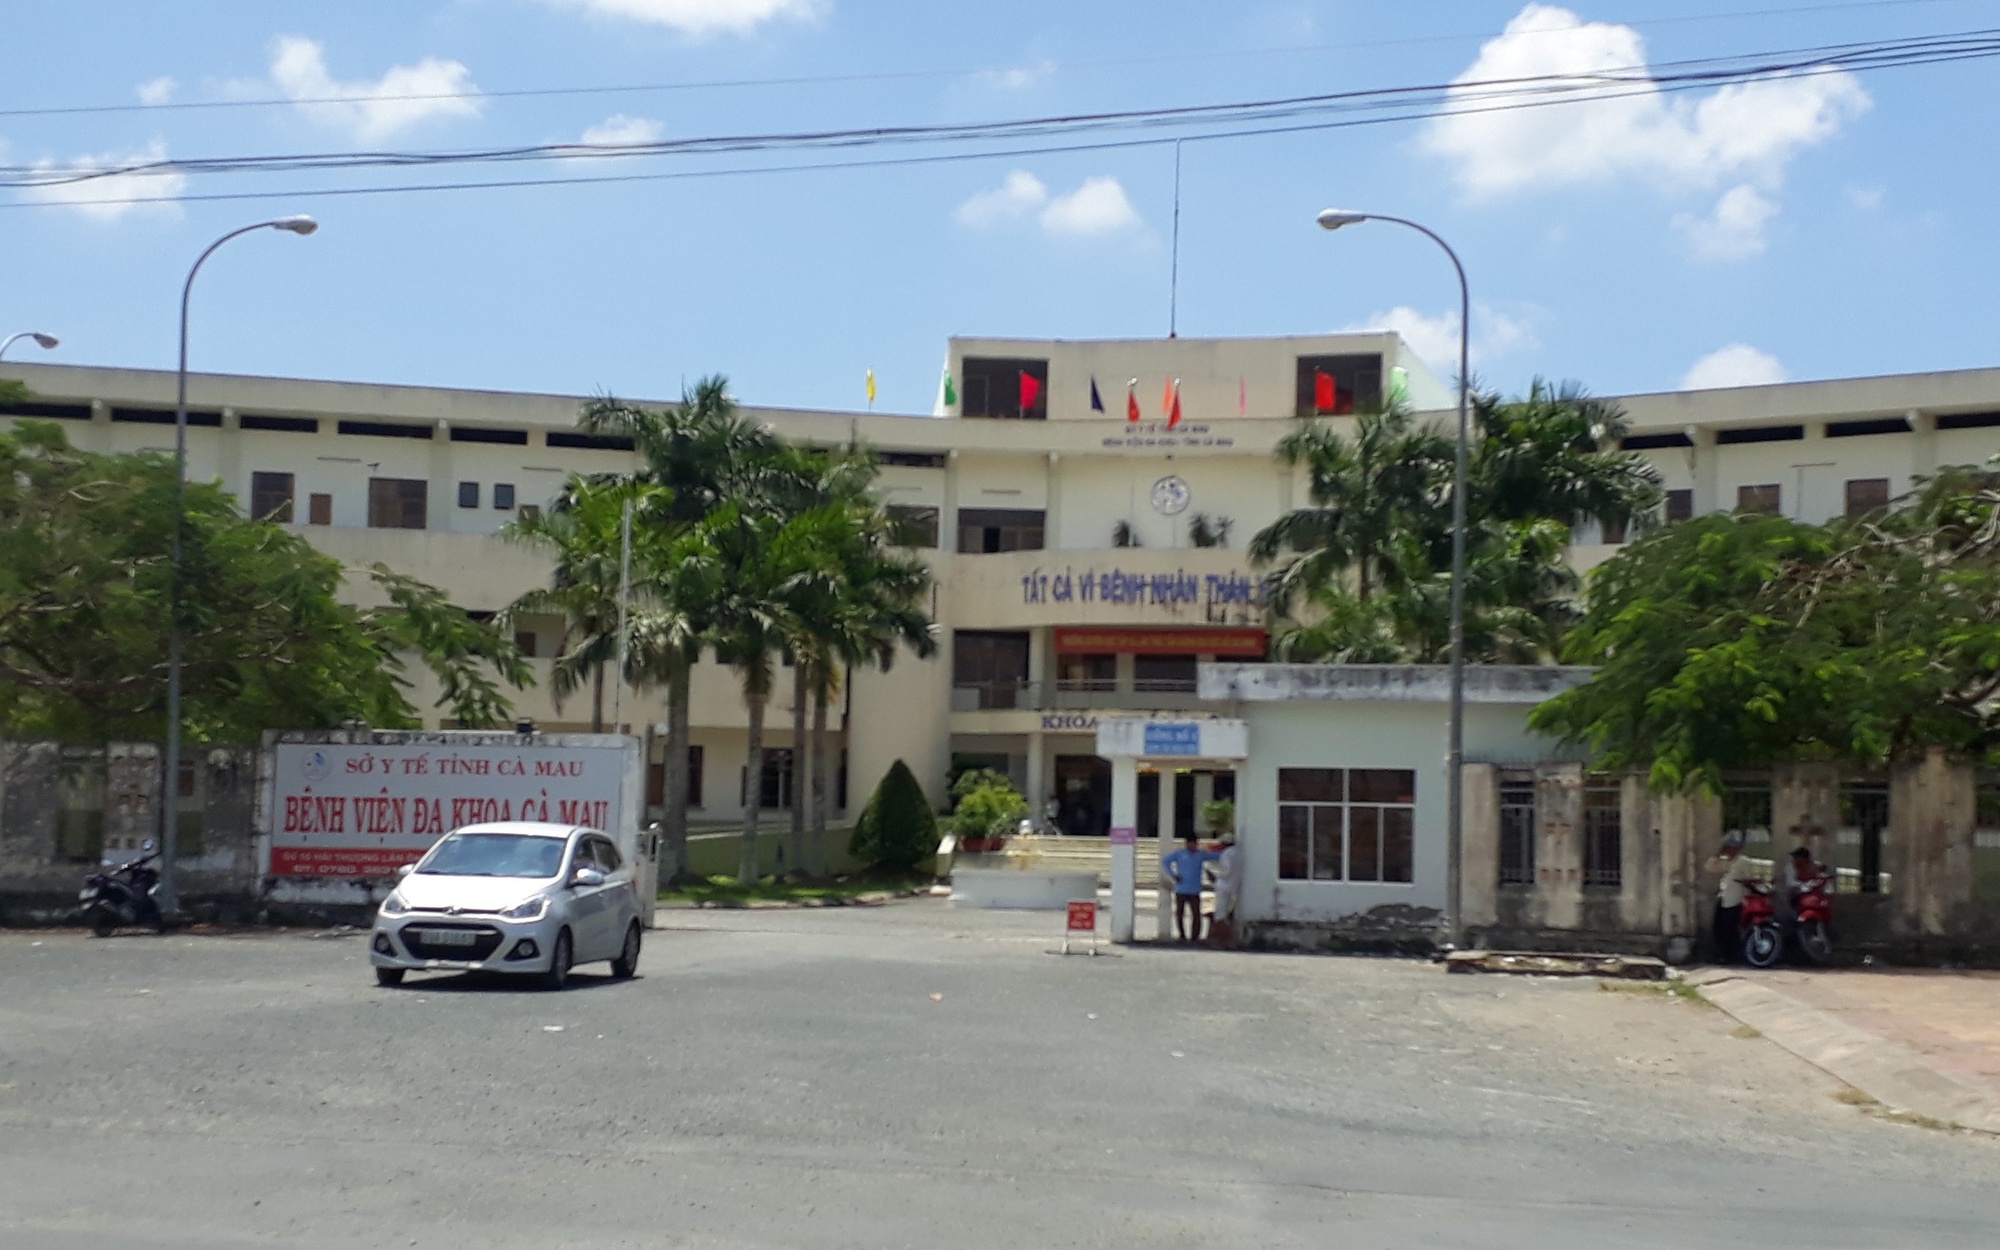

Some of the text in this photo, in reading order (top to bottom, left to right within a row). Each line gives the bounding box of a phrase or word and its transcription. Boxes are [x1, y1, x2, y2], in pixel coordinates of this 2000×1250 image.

[346, 752, 585, 778] SỞ Y TẾ TỈNH CÀ MAU
[284, 785, 609, 845] BỆNH VIỆN ĐA KHOA CÀ MAU
